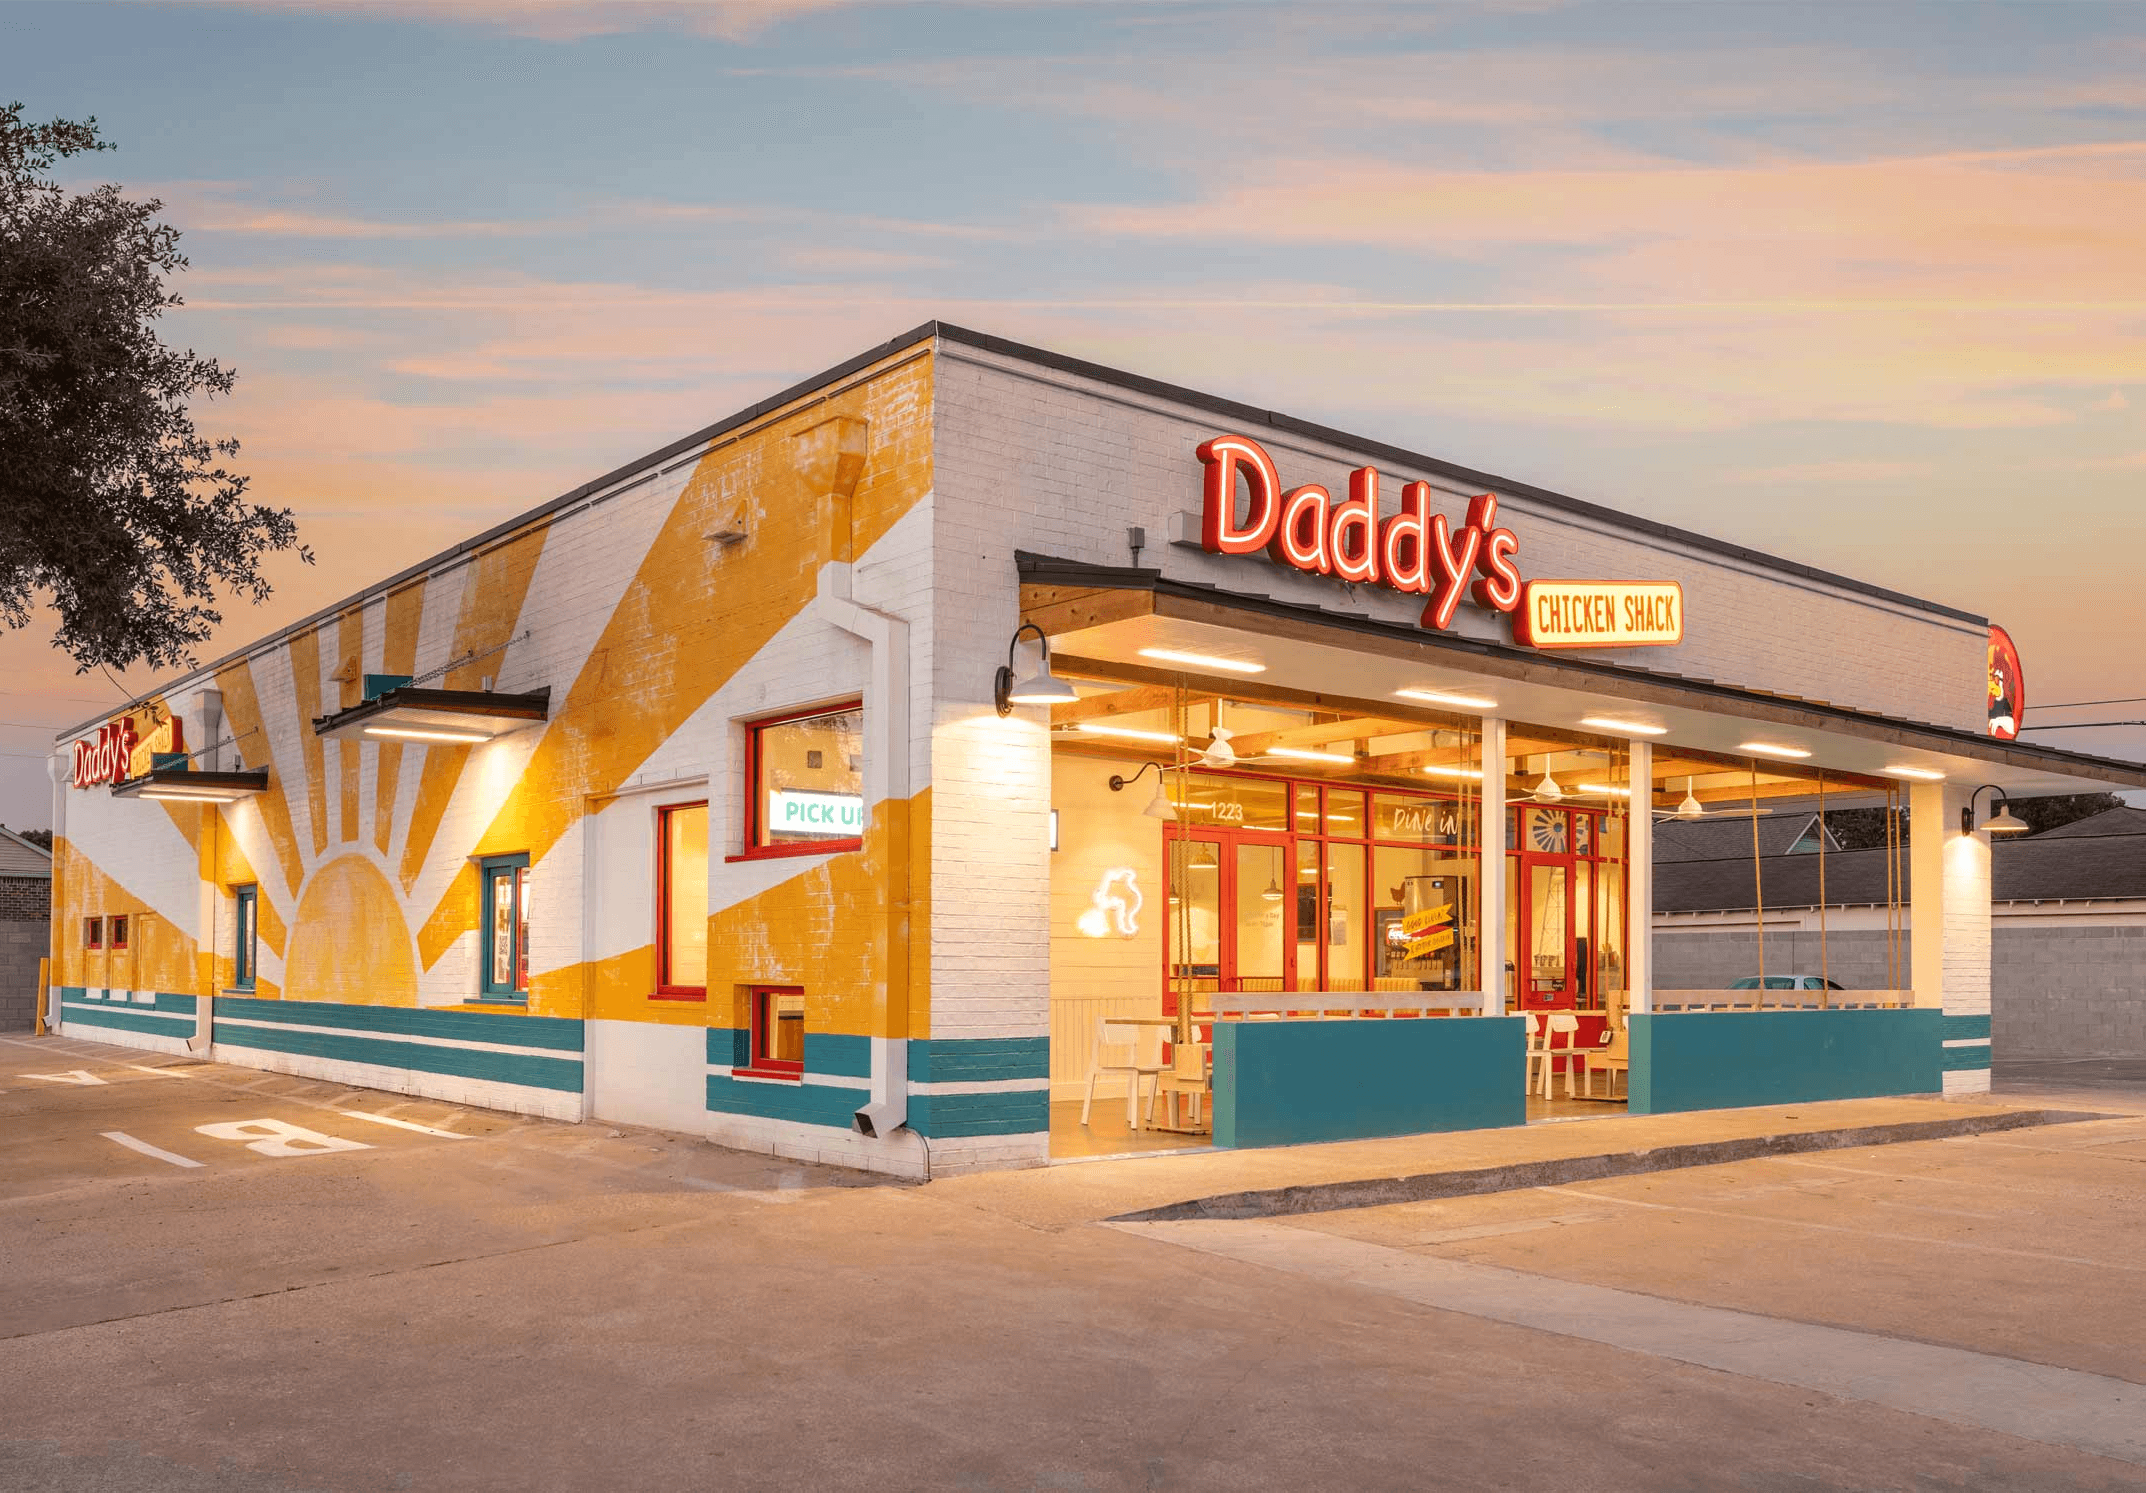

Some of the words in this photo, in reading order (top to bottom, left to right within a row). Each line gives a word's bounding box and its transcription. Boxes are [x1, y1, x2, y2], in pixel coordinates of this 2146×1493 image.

[1196, 434, 1521, 630] Daddy's
[1537, 594, 1616, 634] CHICKEN
[1624, 594, 1676, 632] SHACK
[73, 716, 136, 789] Daddy's
[785, 801, 835, 824] PICK
[1211, 801, 1243, 821] 1223
